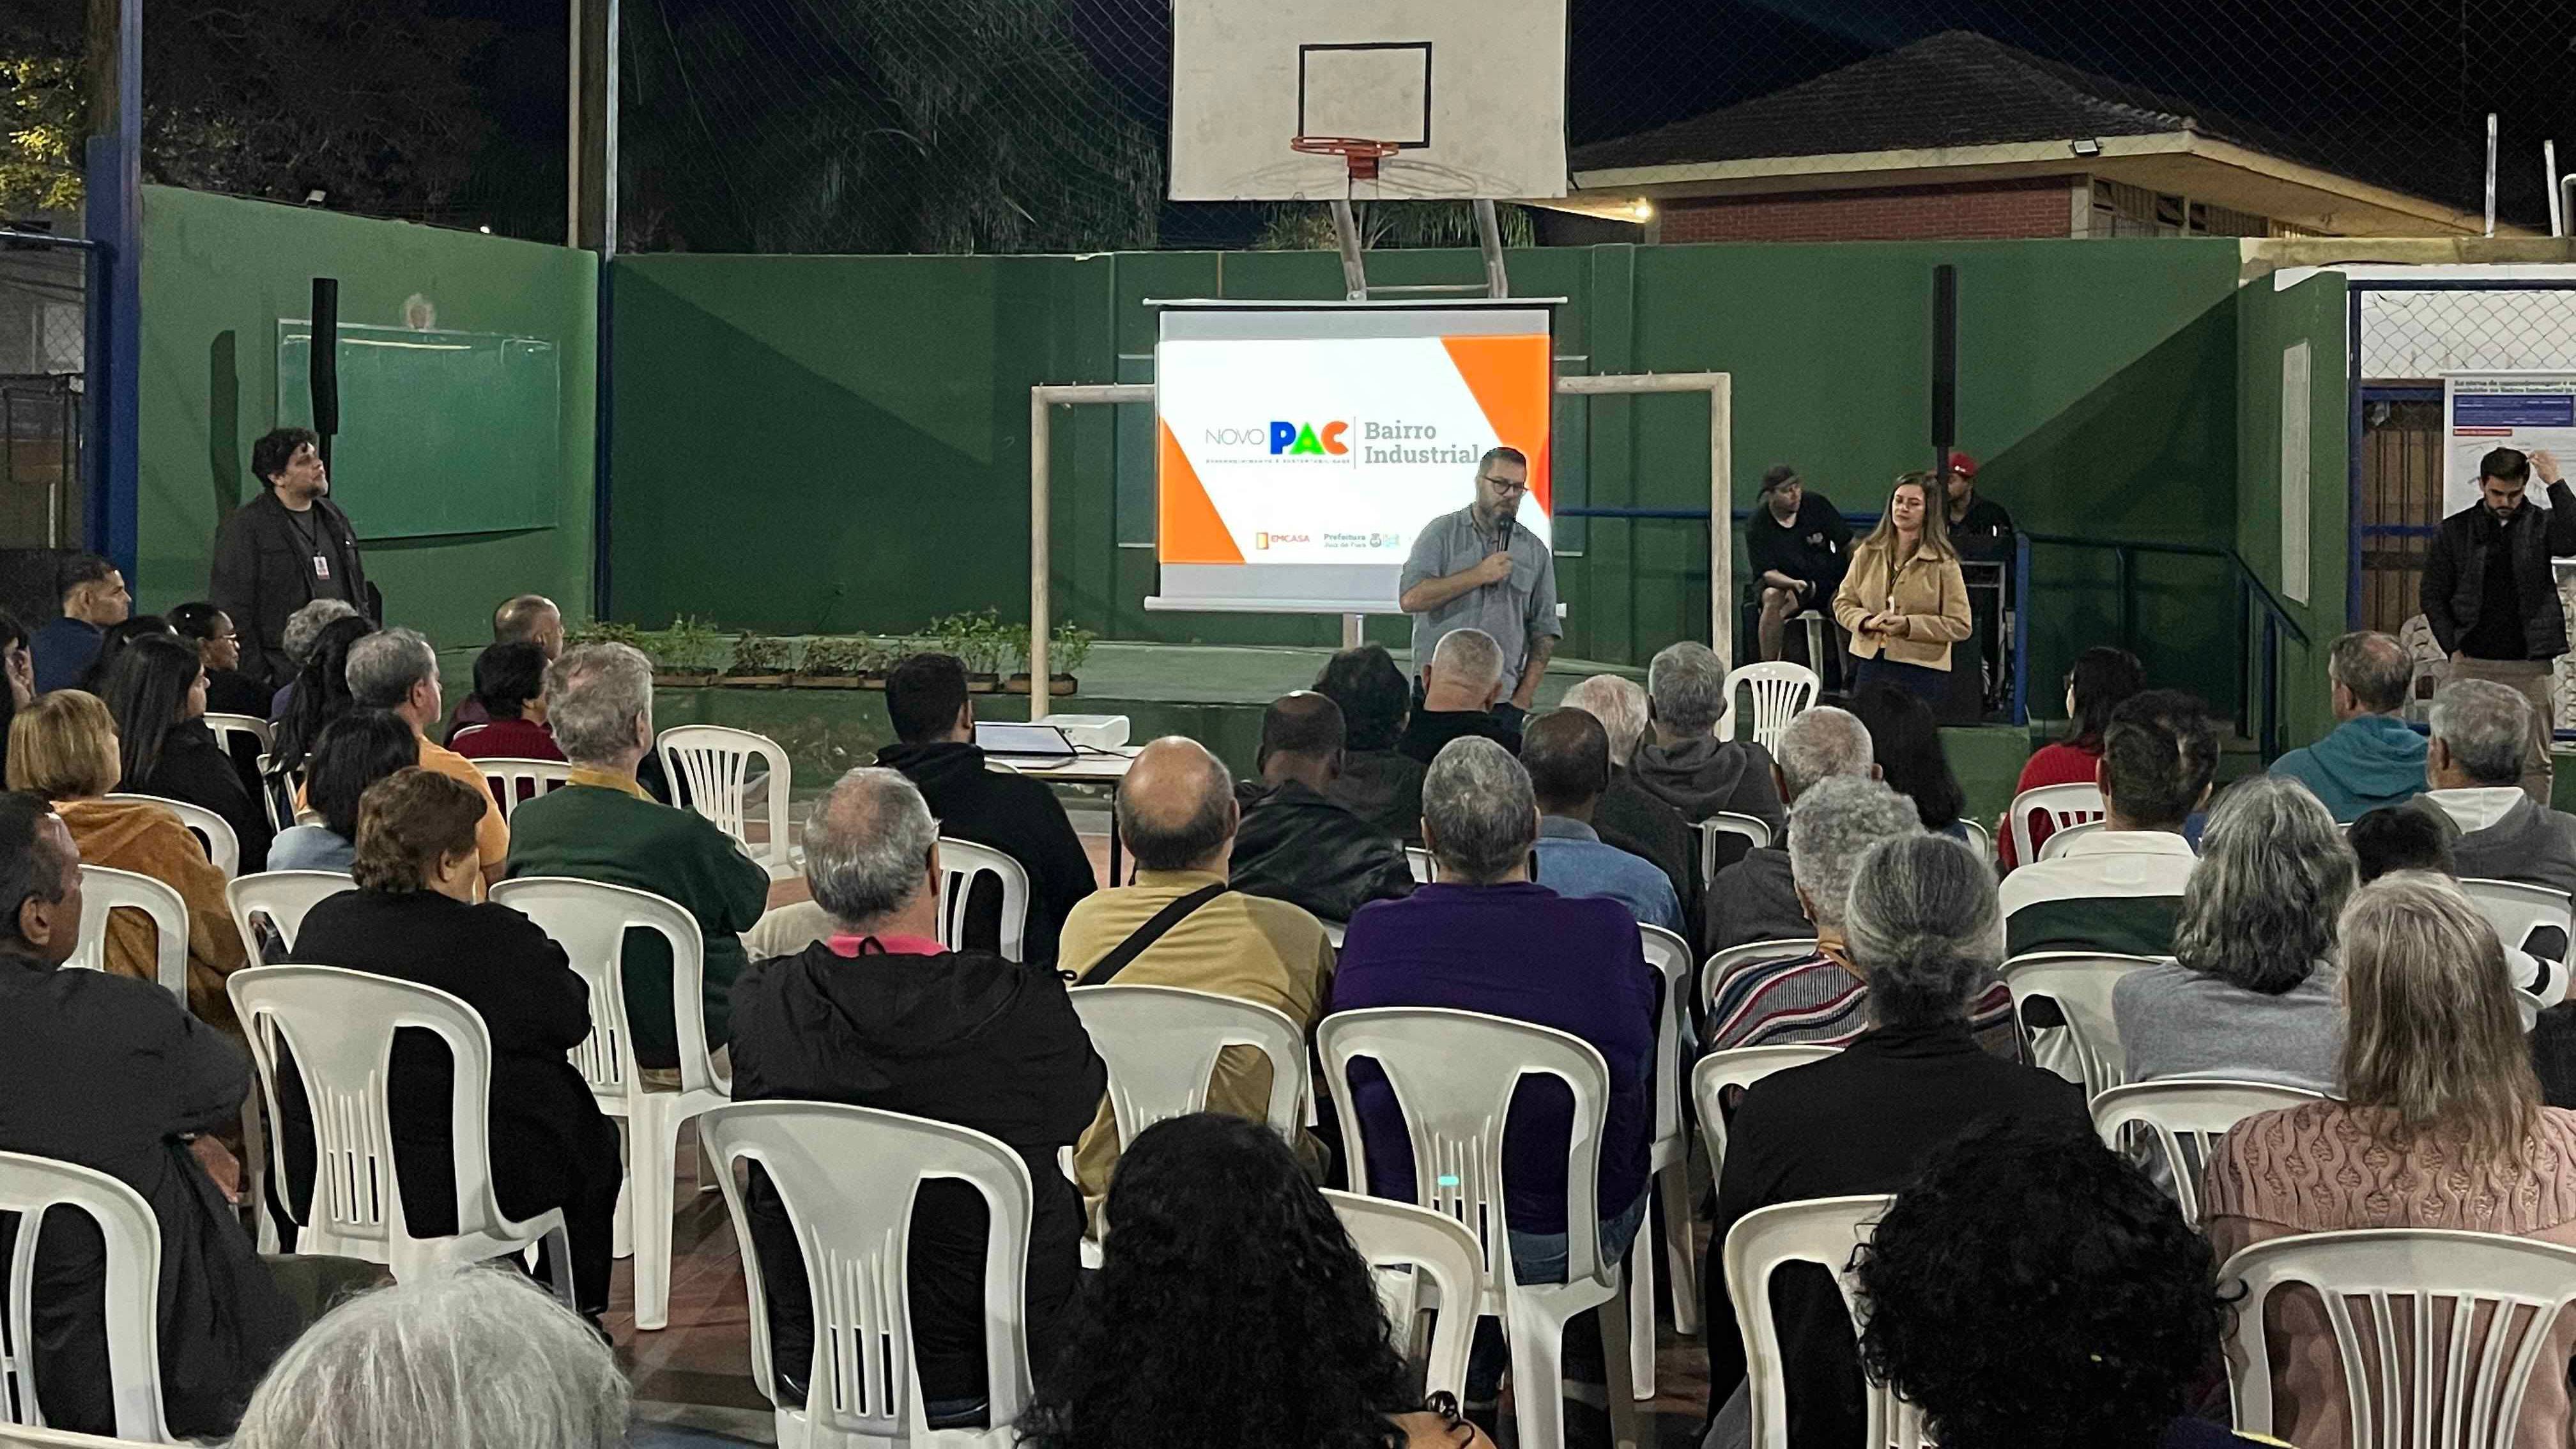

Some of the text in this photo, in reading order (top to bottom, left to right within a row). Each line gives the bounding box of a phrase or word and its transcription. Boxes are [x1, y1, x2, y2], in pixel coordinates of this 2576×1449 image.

[1206, 420, 1349, 456] NOVO PAC
[1364, 419, 1437, 440] Bairro
[1364, 444, 1479, 464] Industrial
[1271, 534, 1310, 542] EMCASA
